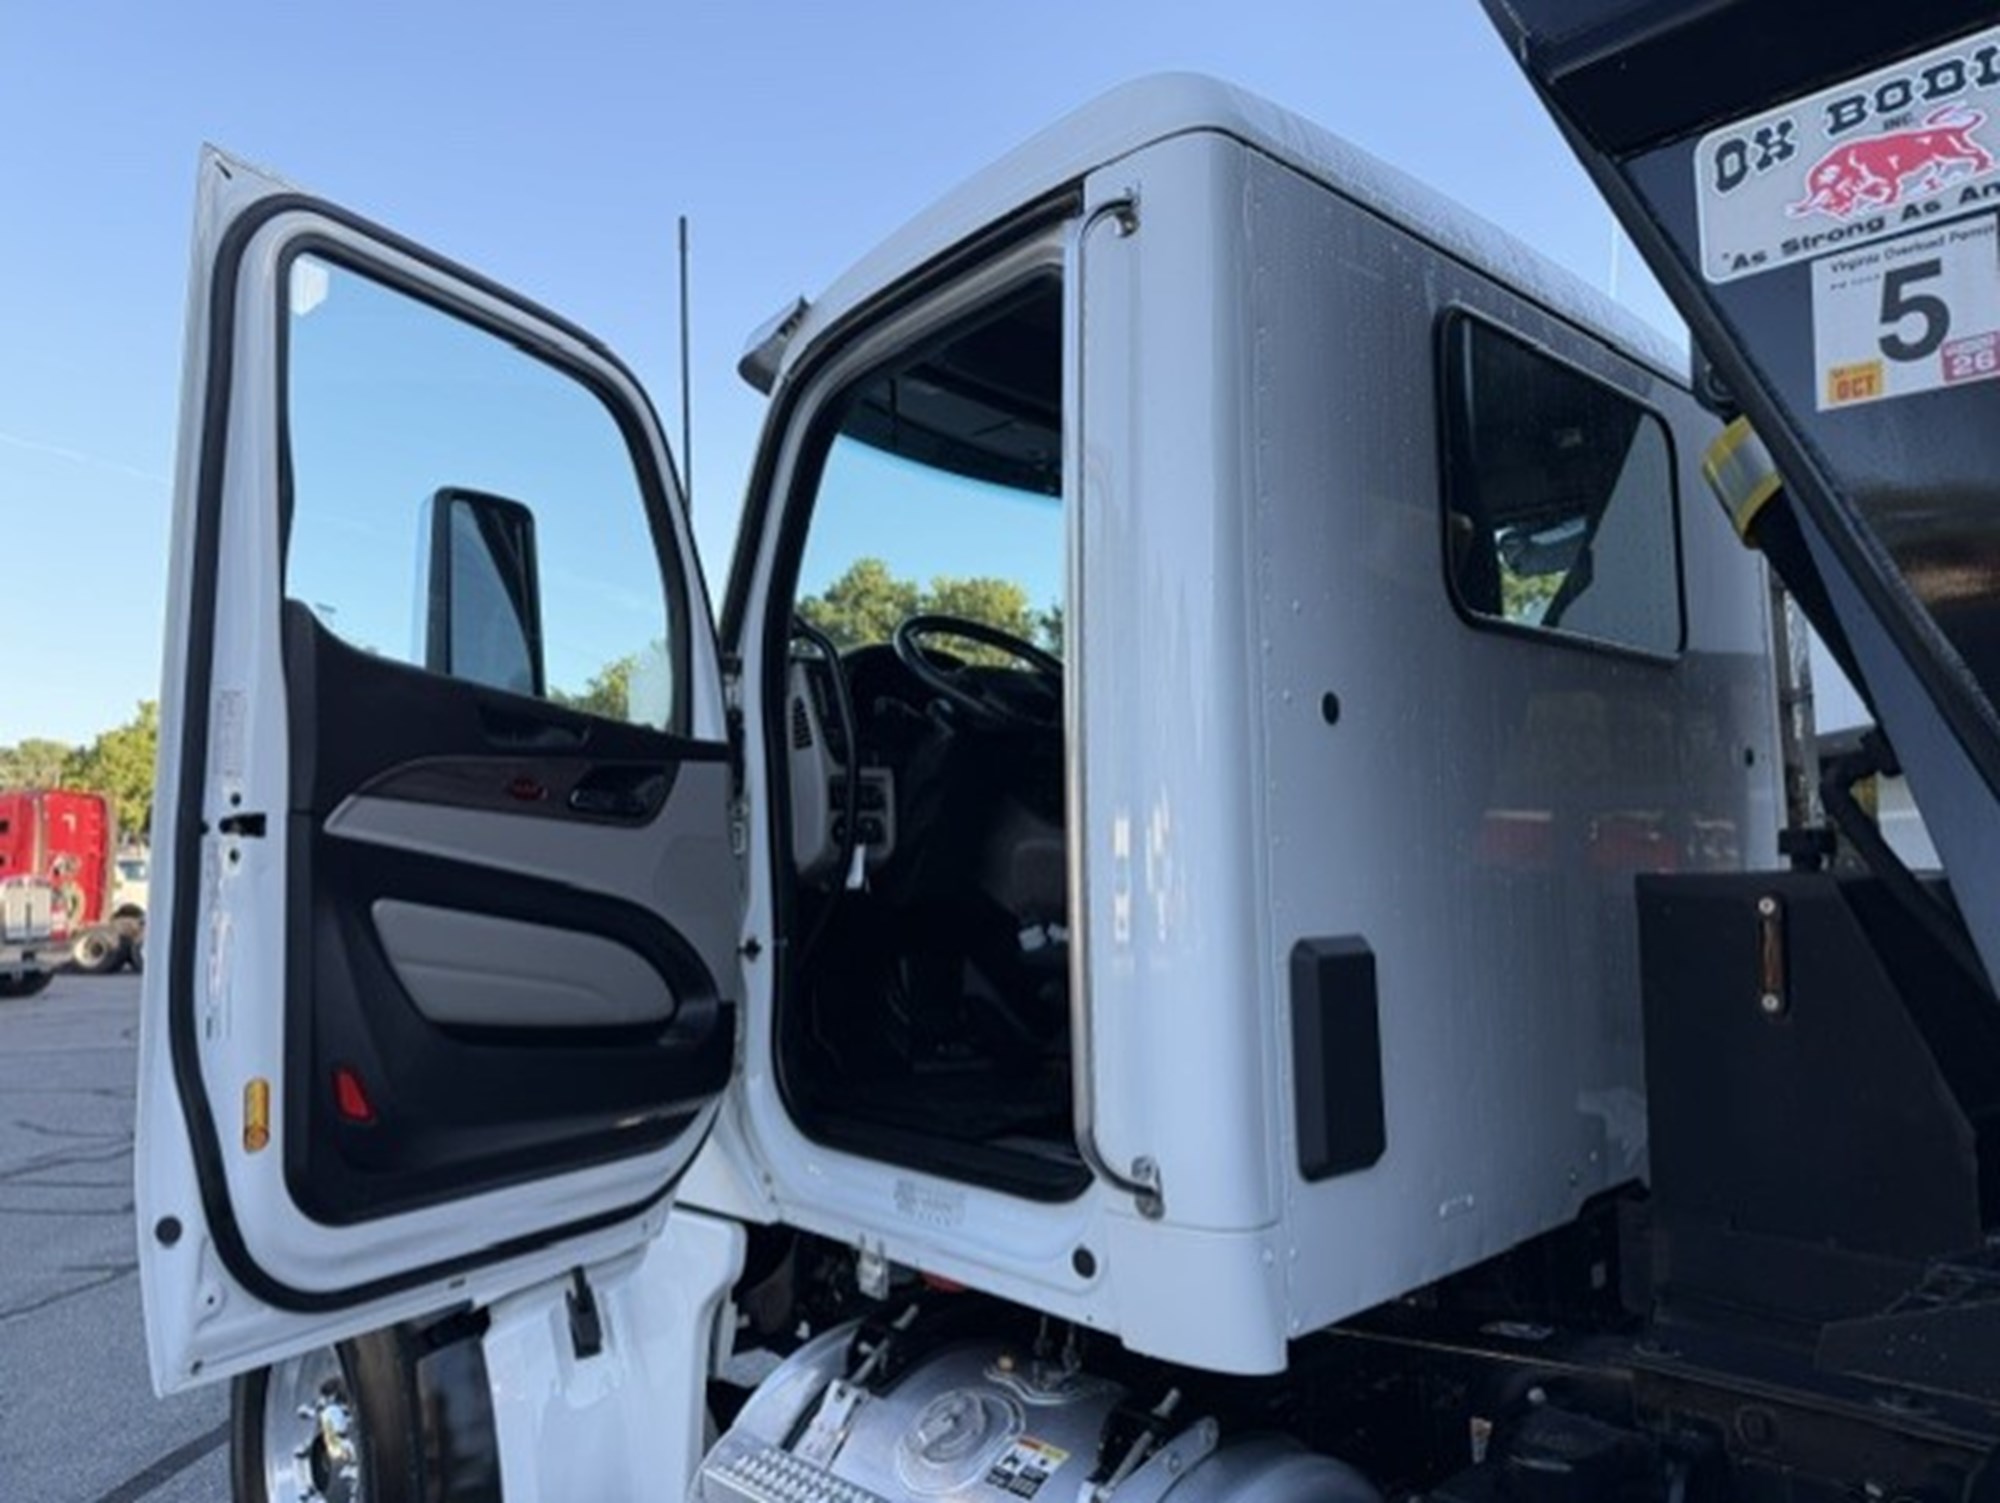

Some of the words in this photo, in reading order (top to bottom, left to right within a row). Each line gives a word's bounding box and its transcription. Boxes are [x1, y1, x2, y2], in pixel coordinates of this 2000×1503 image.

[1715, 119, 1795, 192] OX
[1781, 217, 1885, 256] Strong
[1902, 201, 1941, 221] As
[1878, 258, 1951, 362] 5
[1836, 373, 1876, 400] OCT
[1952, 350, 1995, 376] 26
